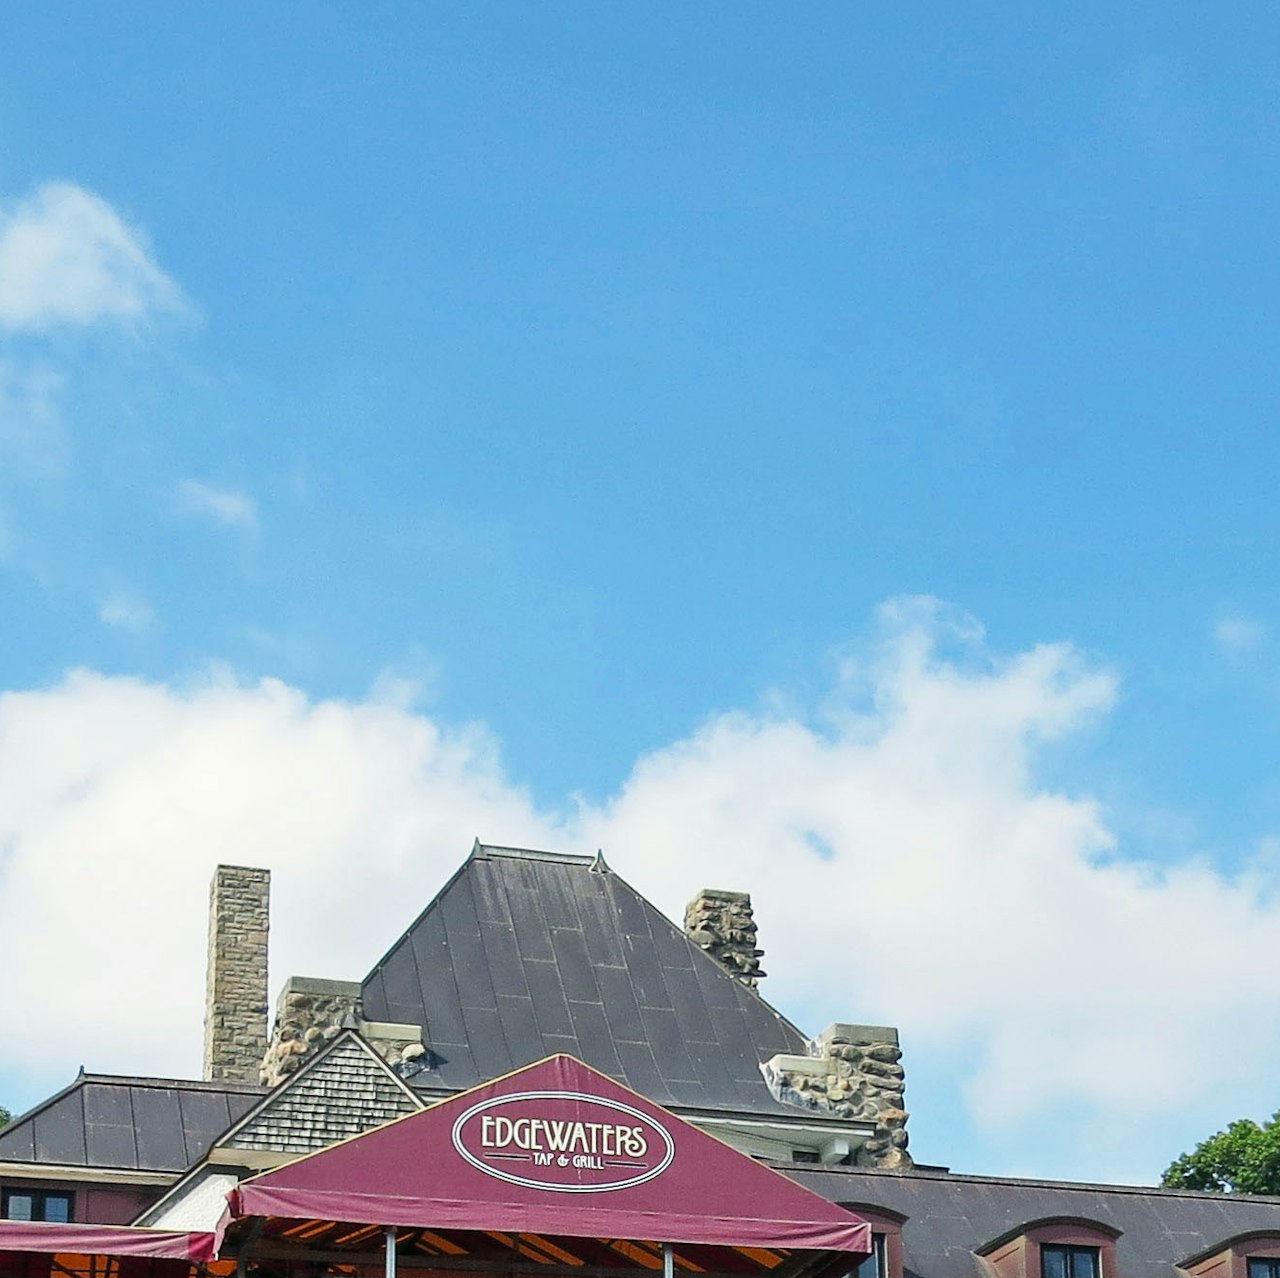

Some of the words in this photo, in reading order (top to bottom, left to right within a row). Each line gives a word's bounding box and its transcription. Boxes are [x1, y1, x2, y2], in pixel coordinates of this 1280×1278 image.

[481, 1115, 647, 1158] EDGEWATERS
[532, 1152, 554, 1167] TAP
[557, 1154, 570, 1167] &
[572, 1154, 604, 1170] GRILL
